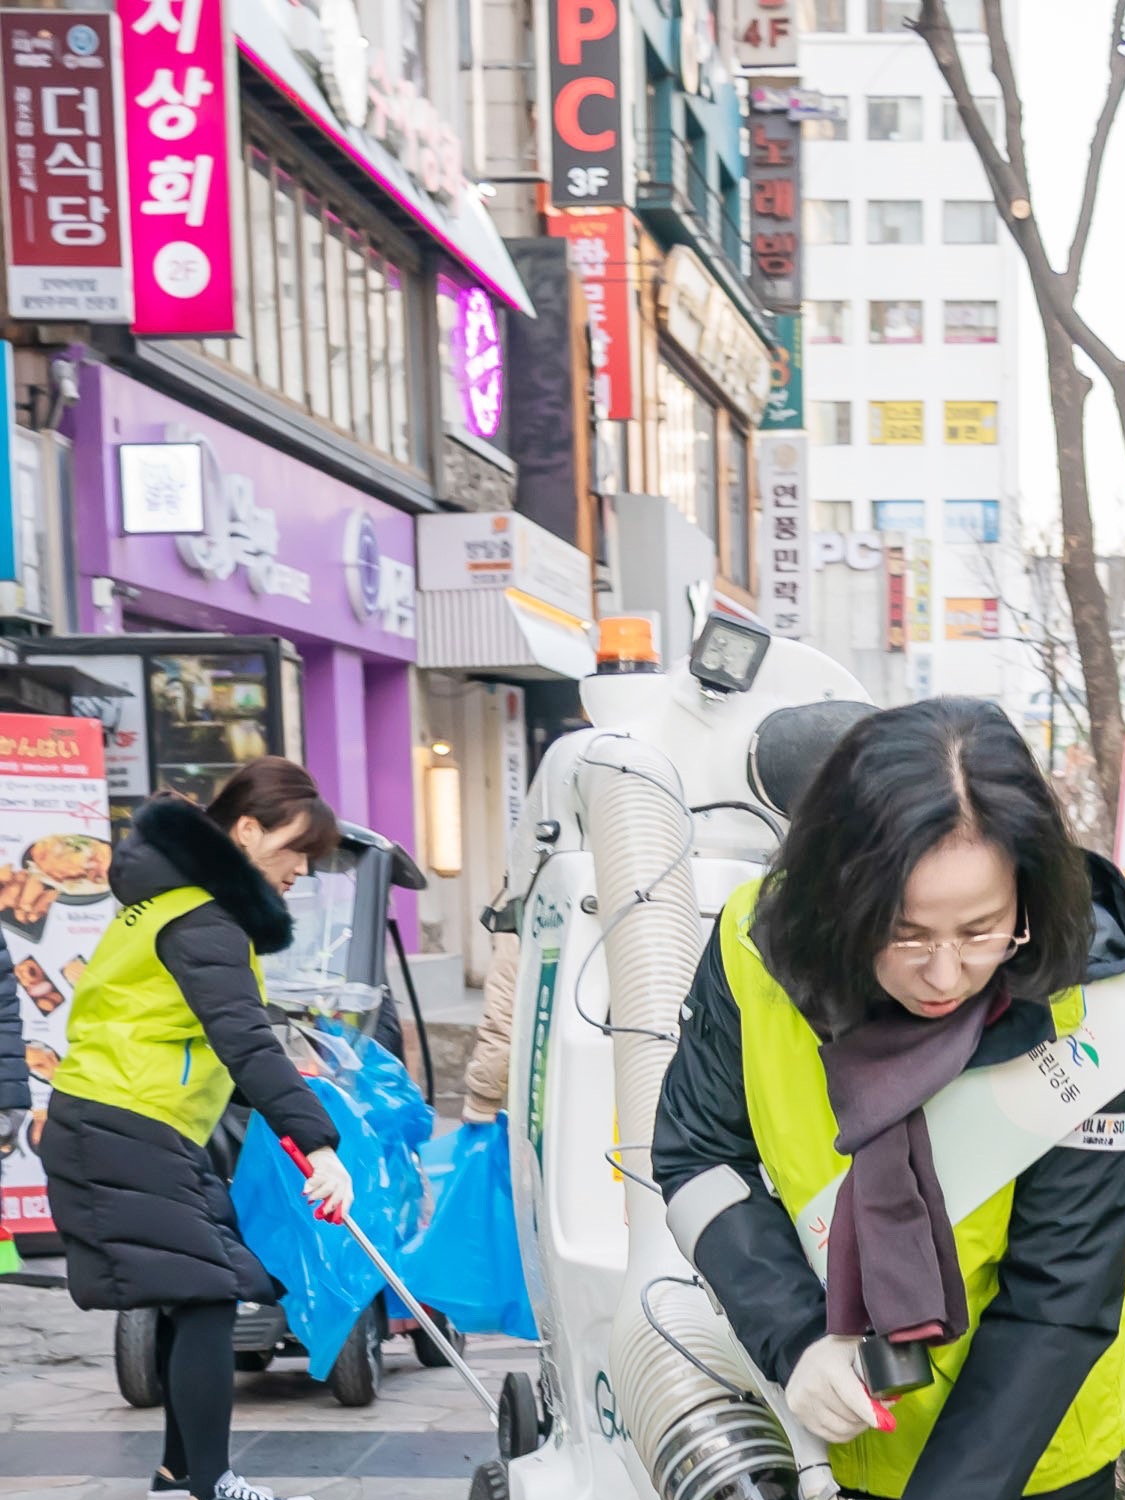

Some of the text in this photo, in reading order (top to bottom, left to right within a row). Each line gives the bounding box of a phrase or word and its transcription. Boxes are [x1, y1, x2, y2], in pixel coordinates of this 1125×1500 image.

[742, 18, 790, 47] 4F
[41, 86, 110, 246] 더식당
[566, 167, 610, 198] 3F
[753, 124, 797, 277] 노래방
[810, 531, 884, 572] PC
